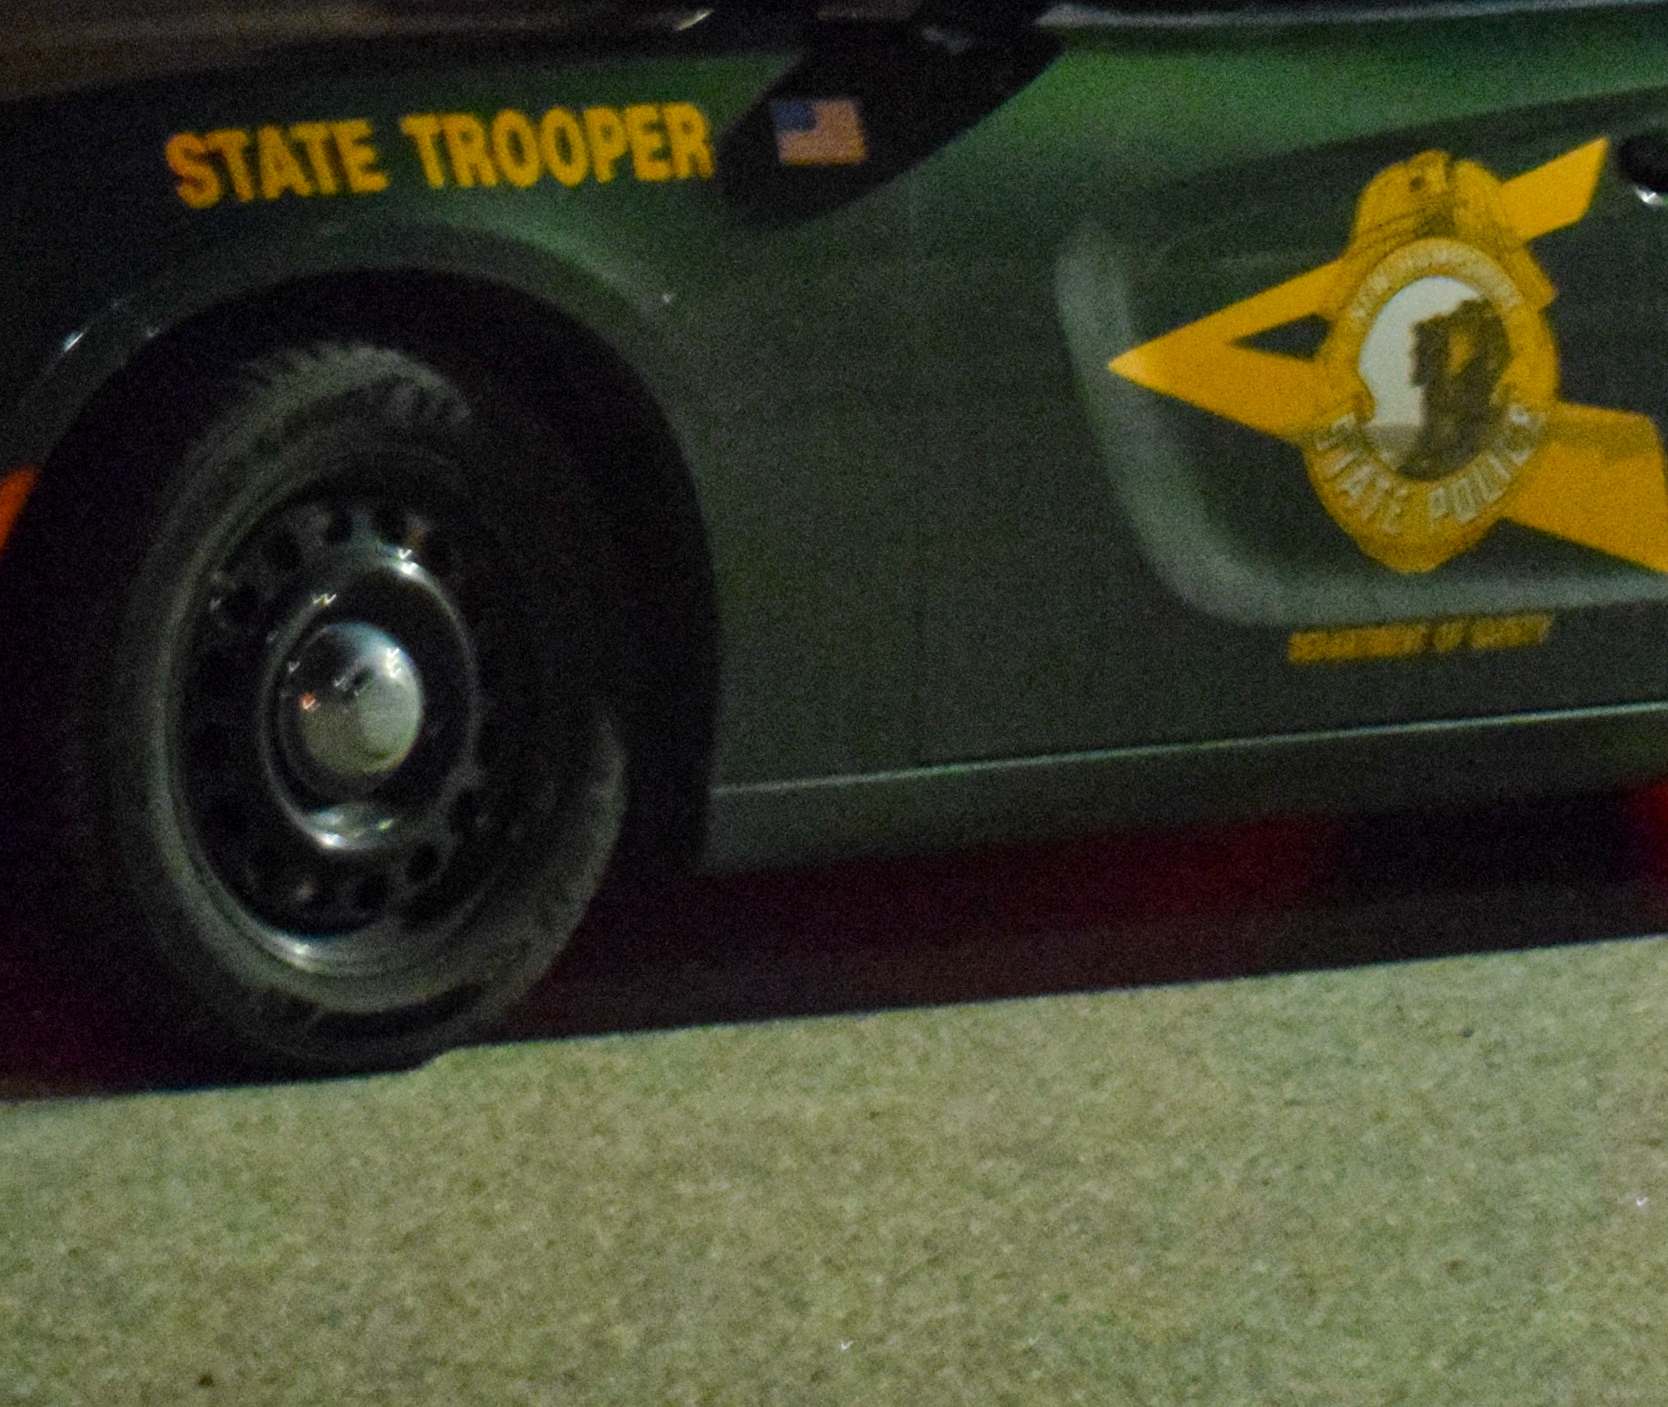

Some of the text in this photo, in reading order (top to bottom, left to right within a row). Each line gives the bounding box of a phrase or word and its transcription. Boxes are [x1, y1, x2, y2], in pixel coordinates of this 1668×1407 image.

[164, 101, 715, 209] STATE TROOPER
[1312, 412, 1411, 535] STATE
